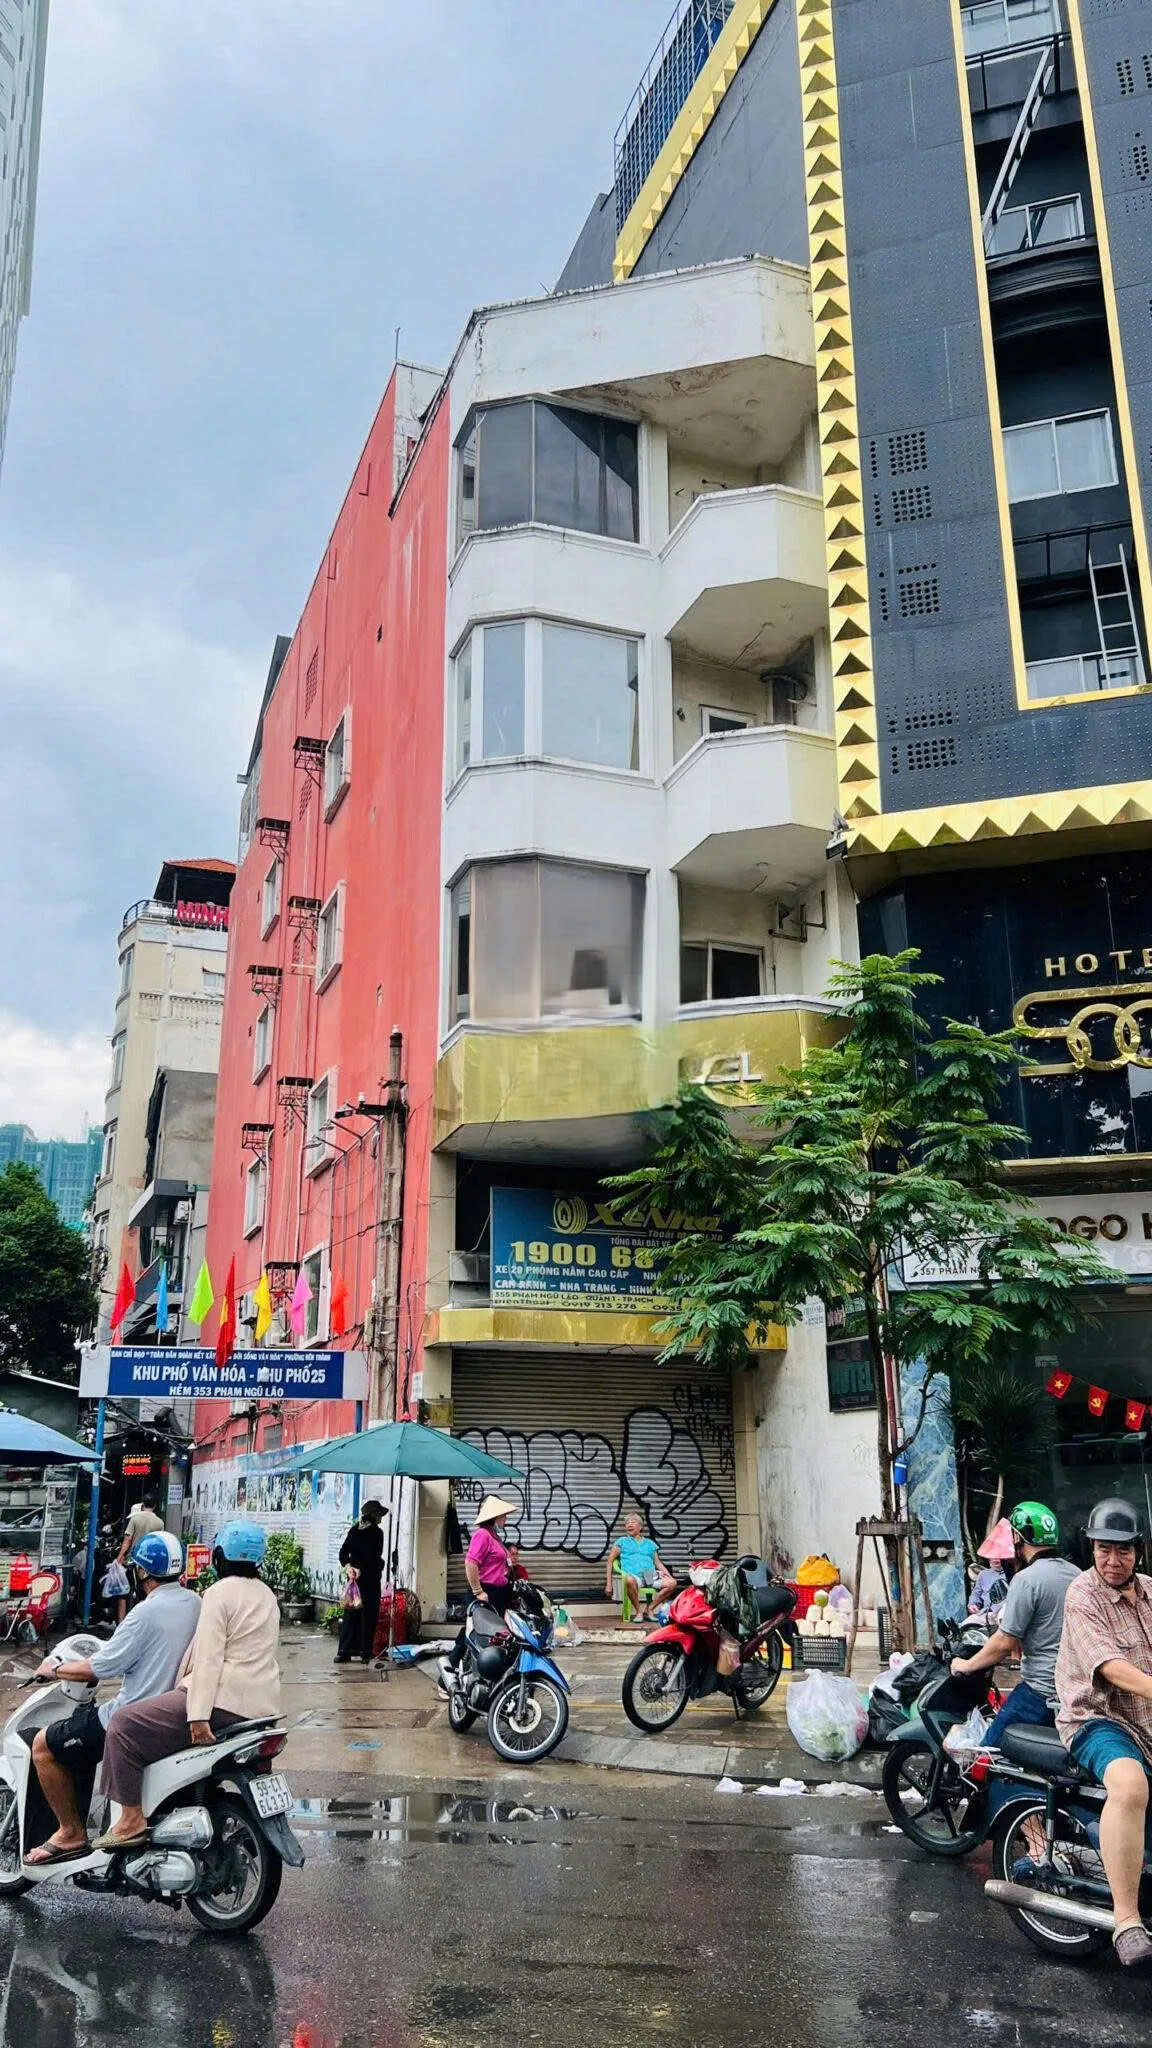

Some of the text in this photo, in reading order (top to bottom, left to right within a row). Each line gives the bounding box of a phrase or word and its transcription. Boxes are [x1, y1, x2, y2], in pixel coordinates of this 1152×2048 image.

[511, 1241, 596, 1266] 1900
[495, 1265, 508, 1274] XE
[526, 1265, 560, 1276] PHÒNG
[562, 1265, 586, 1277] NẰM
[588, 1269, 607, 1278] CAO
[609, 1267, 629, 1279] CẤP
[920, 1268, 935, 1276] 357
[495, 1280, 516, 1289] CAM
[518, 1281, 547, 1290] RANH
[560, 1282, 580, 1291] NHA
[583, 1283, 617, 1293] TRANG
[629, 1285, 653, 1294] NINH
[133, 1365, 160, 1380] KHU
[162, 1361, 190, 1381] PHỐ
[192, 1364, 217, 1381] VĂN
[220, 1363, 246, 1382] HÓA
[169, 1383, 284, 1398] HẺM 353 PHẠM NGŨ LÃO
